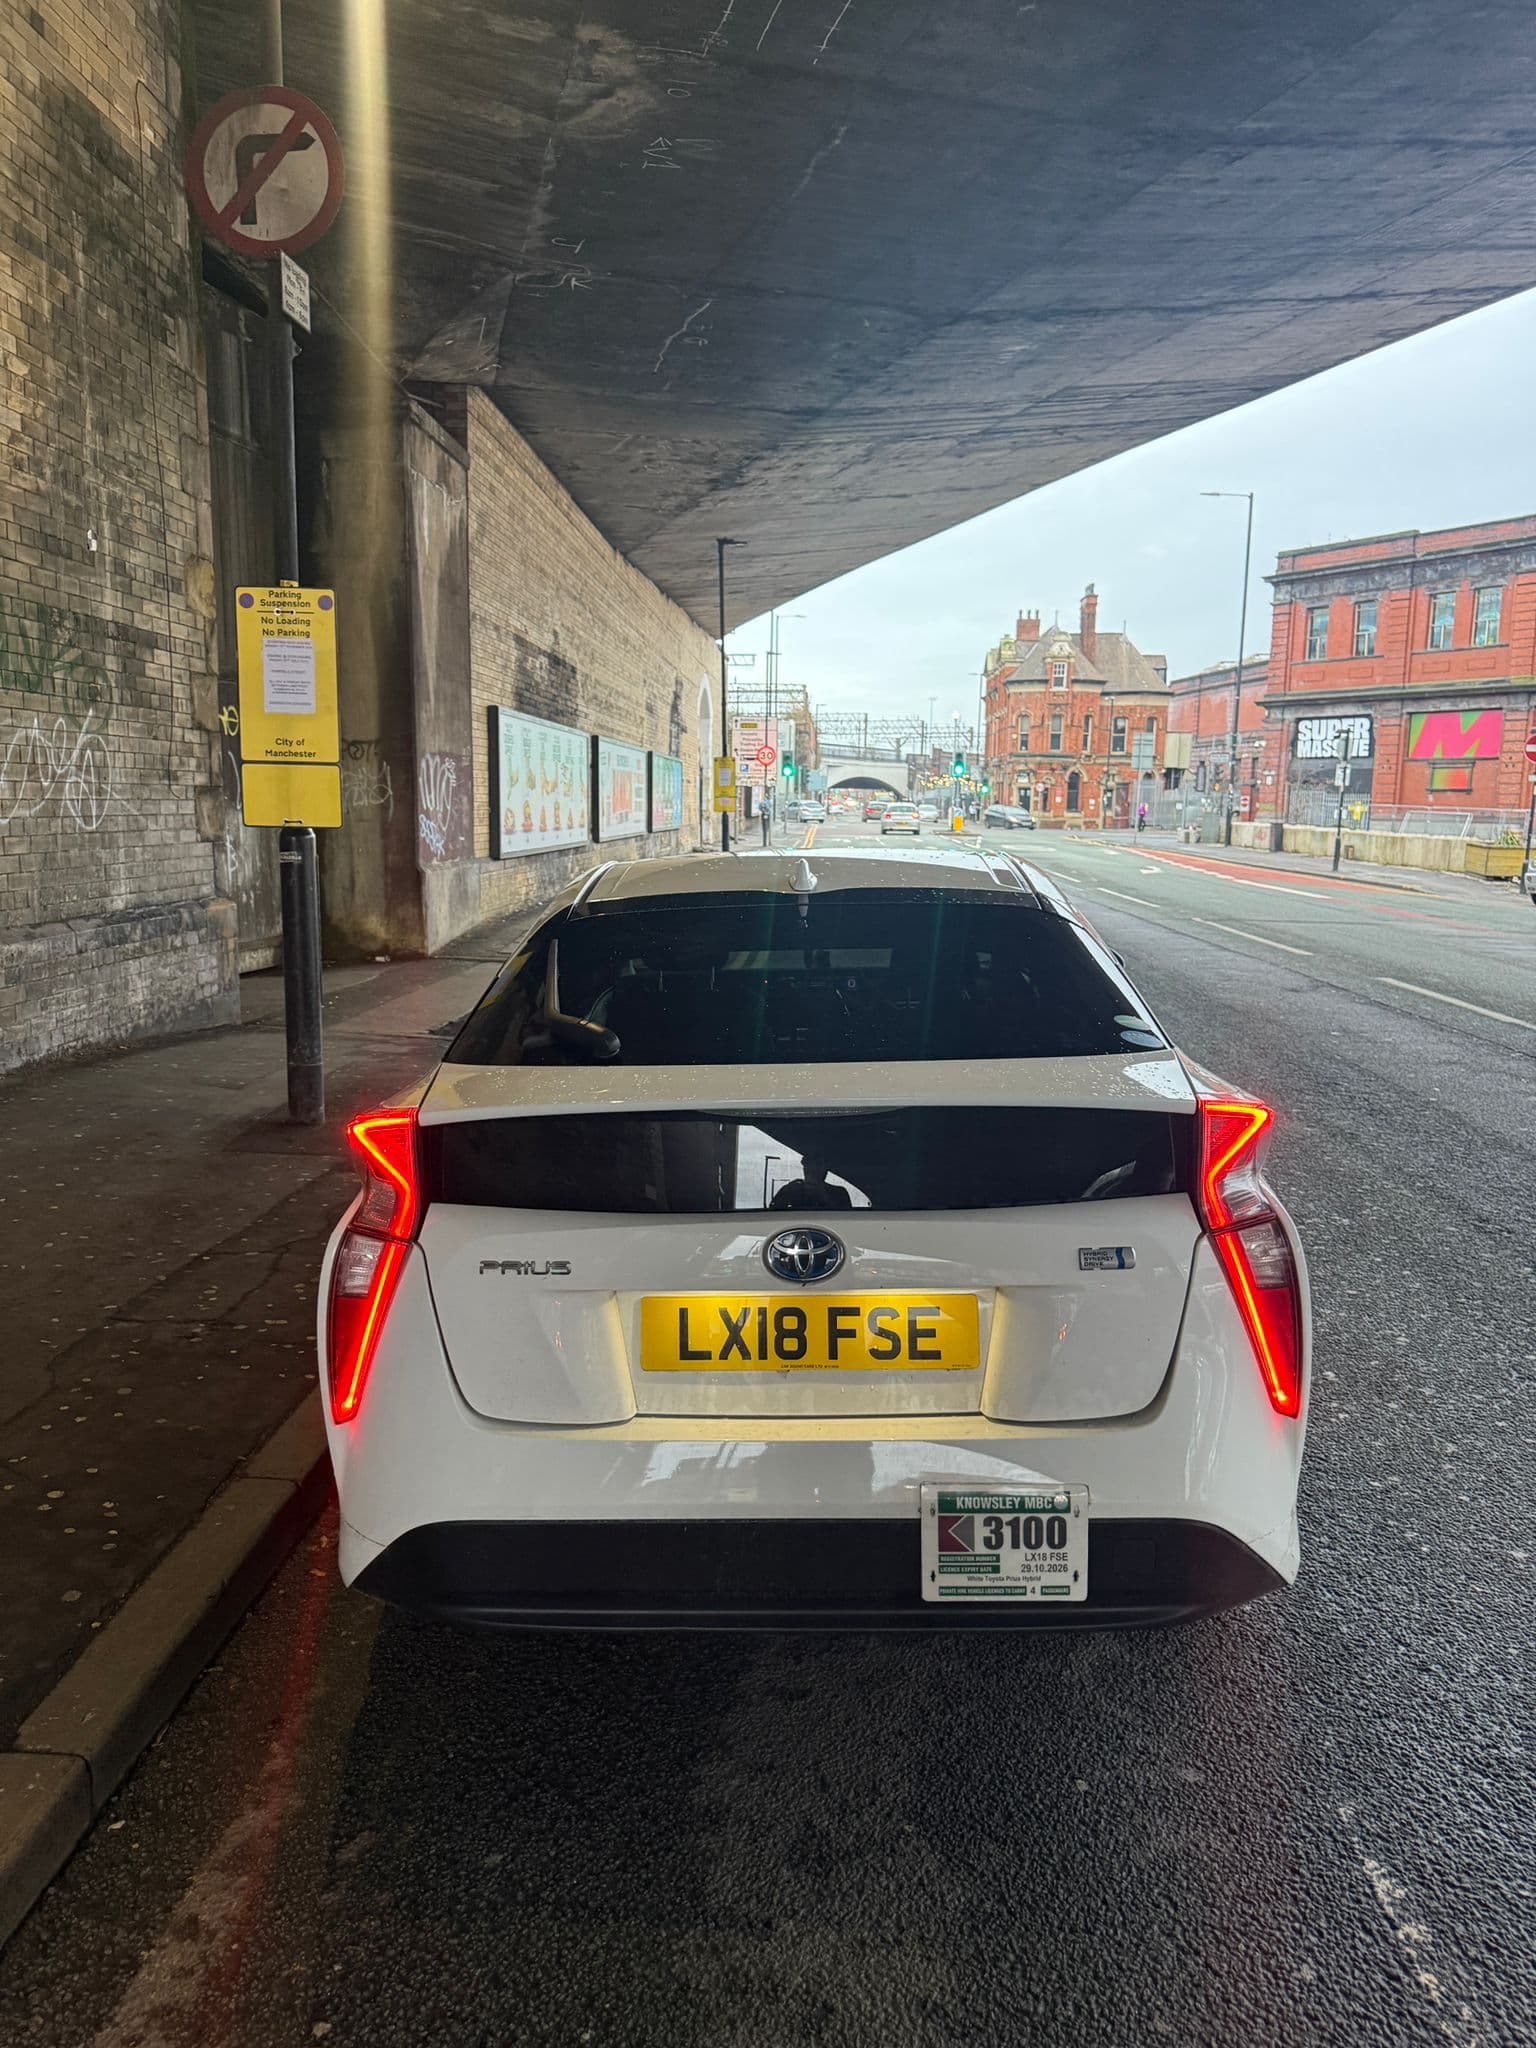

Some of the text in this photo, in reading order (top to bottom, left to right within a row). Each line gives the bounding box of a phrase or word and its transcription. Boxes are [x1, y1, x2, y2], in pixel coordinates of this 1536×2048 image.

[268, 590, 302, 600] Parking
[260, 599, 311, 608] Suspension
[261, 616, 311, 626] No Loading
[262, 628, 311, 638] No Parking
[1298, 717, 1371, 741] SUPER
[275, 737, 305, 747] City of
[265, 749, 317, 758] Manchester
[760, 751, 773, 759] 30
[479, 1260, 572, 1275] PRIUS
[678, 1306, 942, 1361] LX18 FSE
[956, 1496, 1052, 1509] KNOWSLEY MBC
[982, 1515, 1068, 1551] 3100
[1024, 1552, 1068, 1562] LX18 FSE
[1020, 1563, 1068, 1573] 29.10.2026
